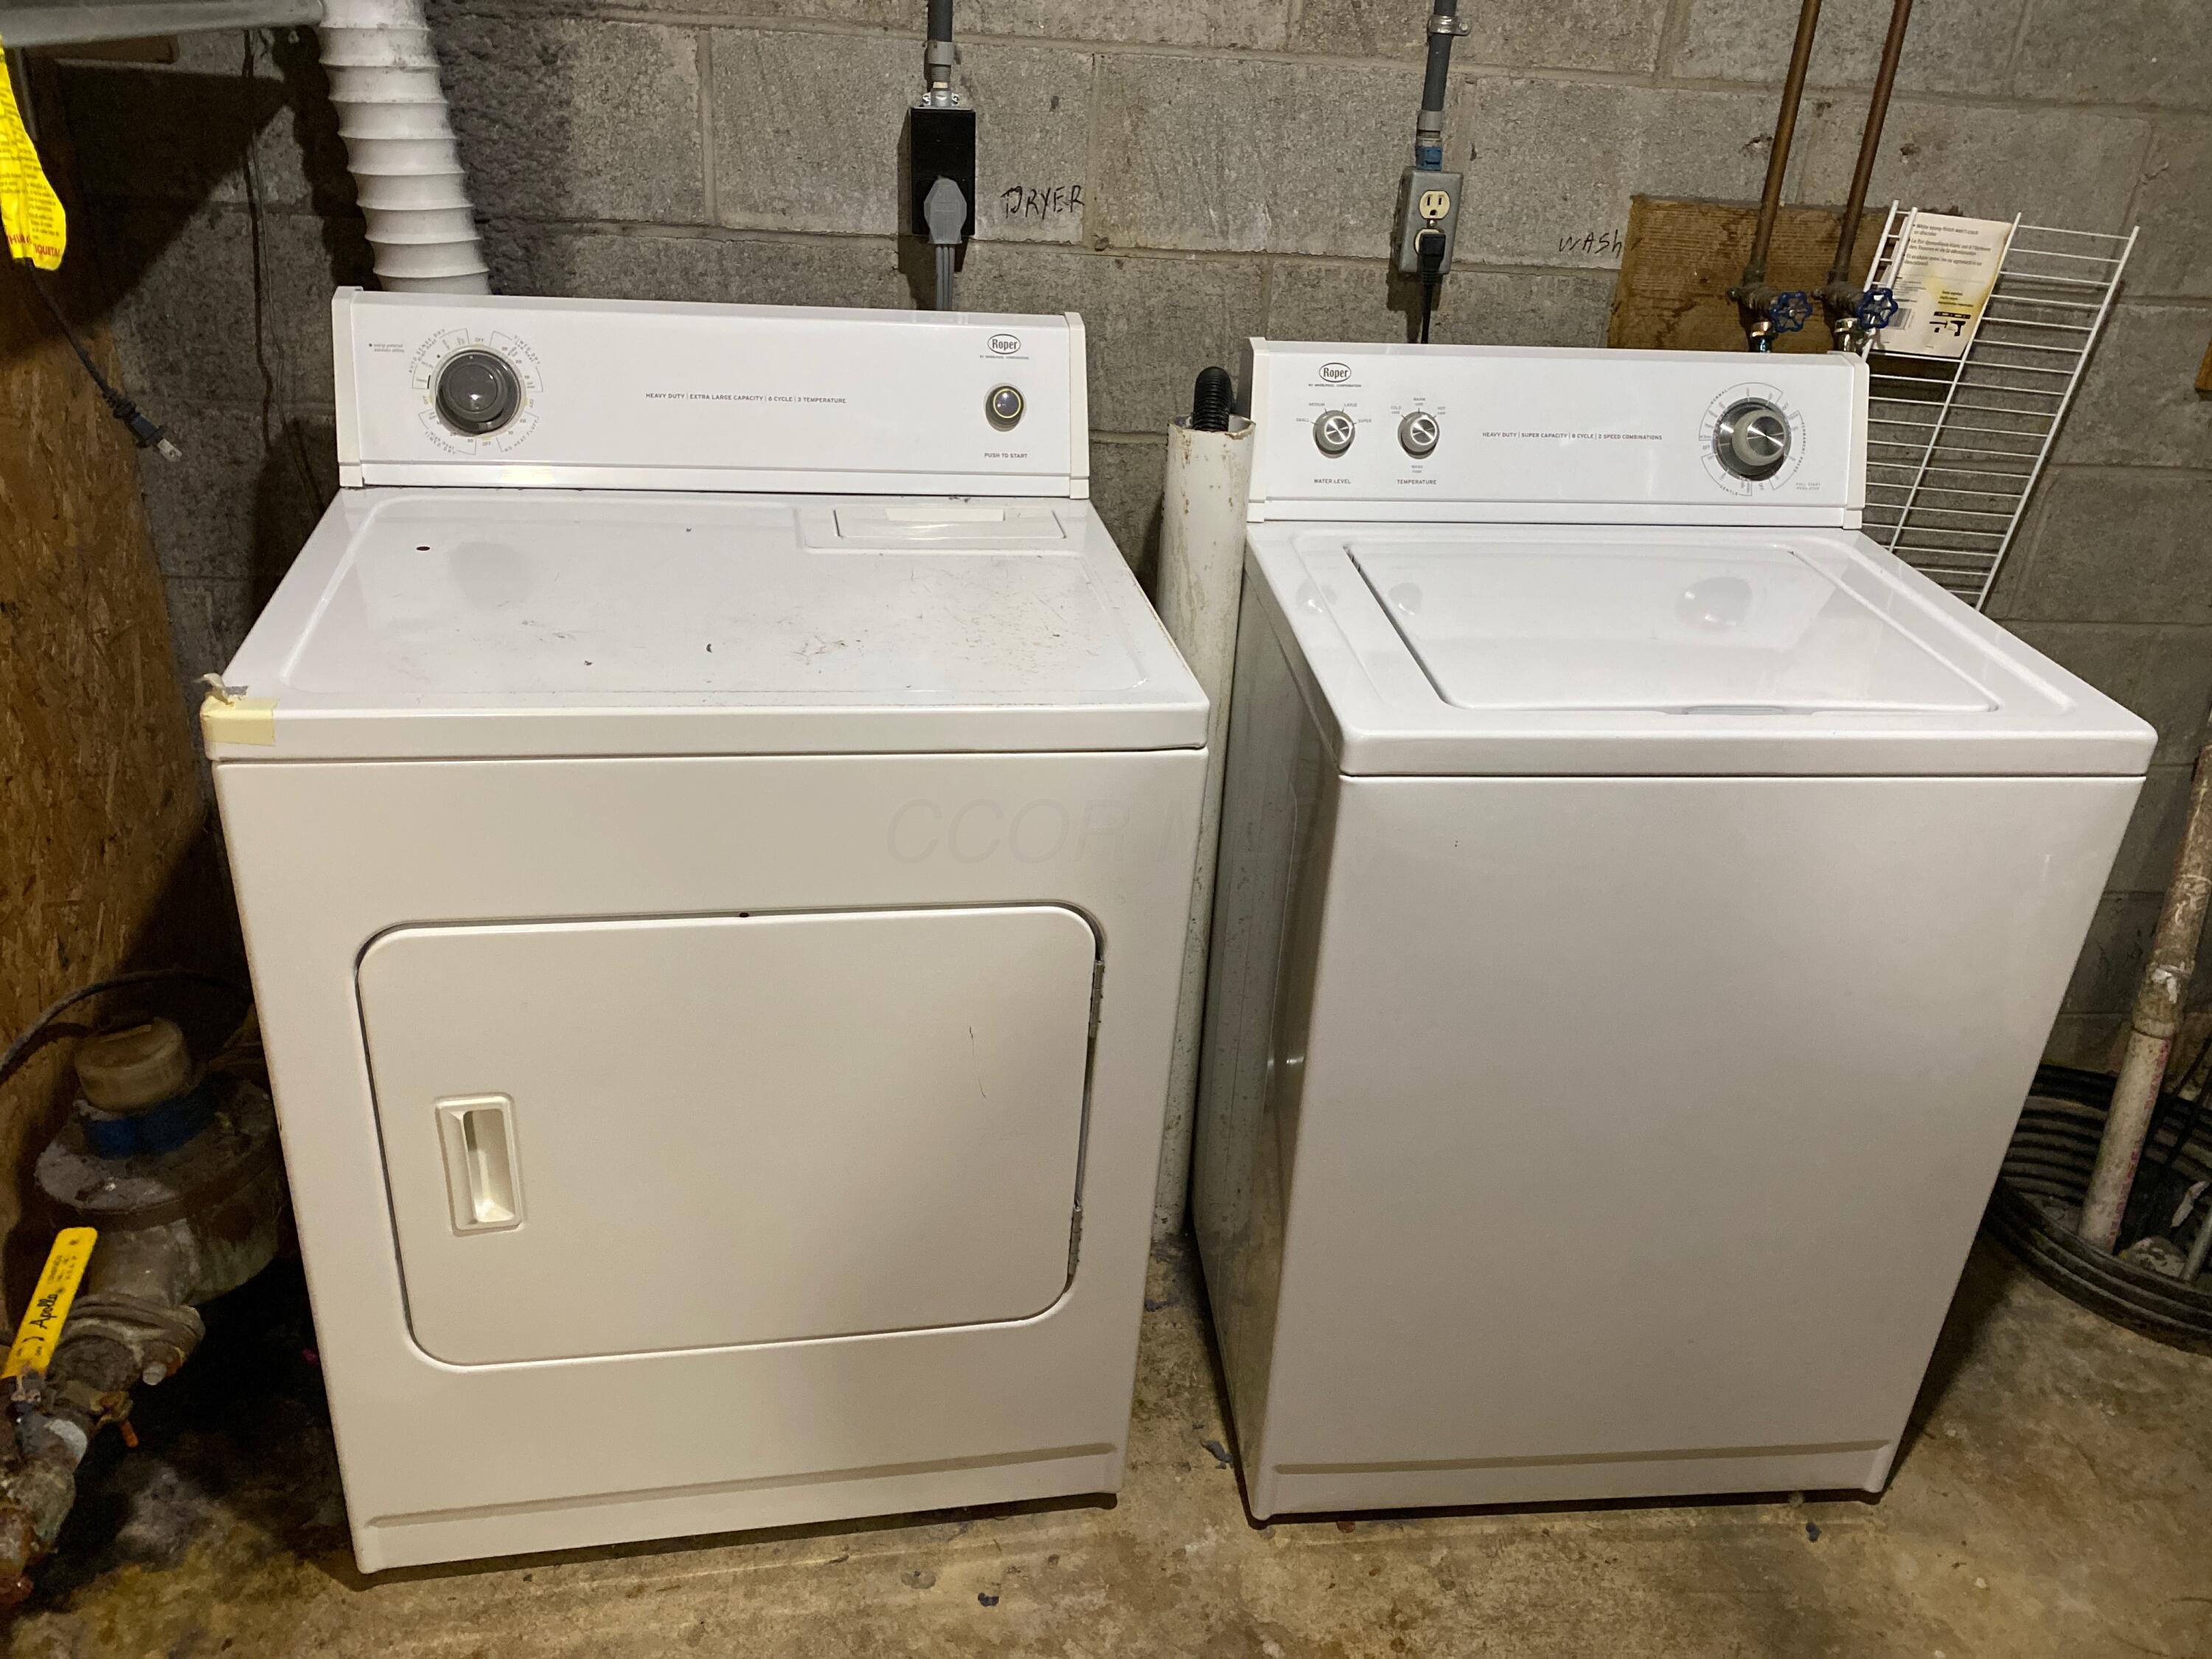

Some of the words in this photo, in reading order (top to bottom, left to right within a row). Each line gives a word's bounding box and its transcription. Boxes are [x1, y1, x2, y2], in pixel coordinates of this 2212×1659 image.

[1001, 185, 1085, 220] DRYER
[992, 338, 1018, 351] Roper
[1323, 367, 1349, 379] Roper
